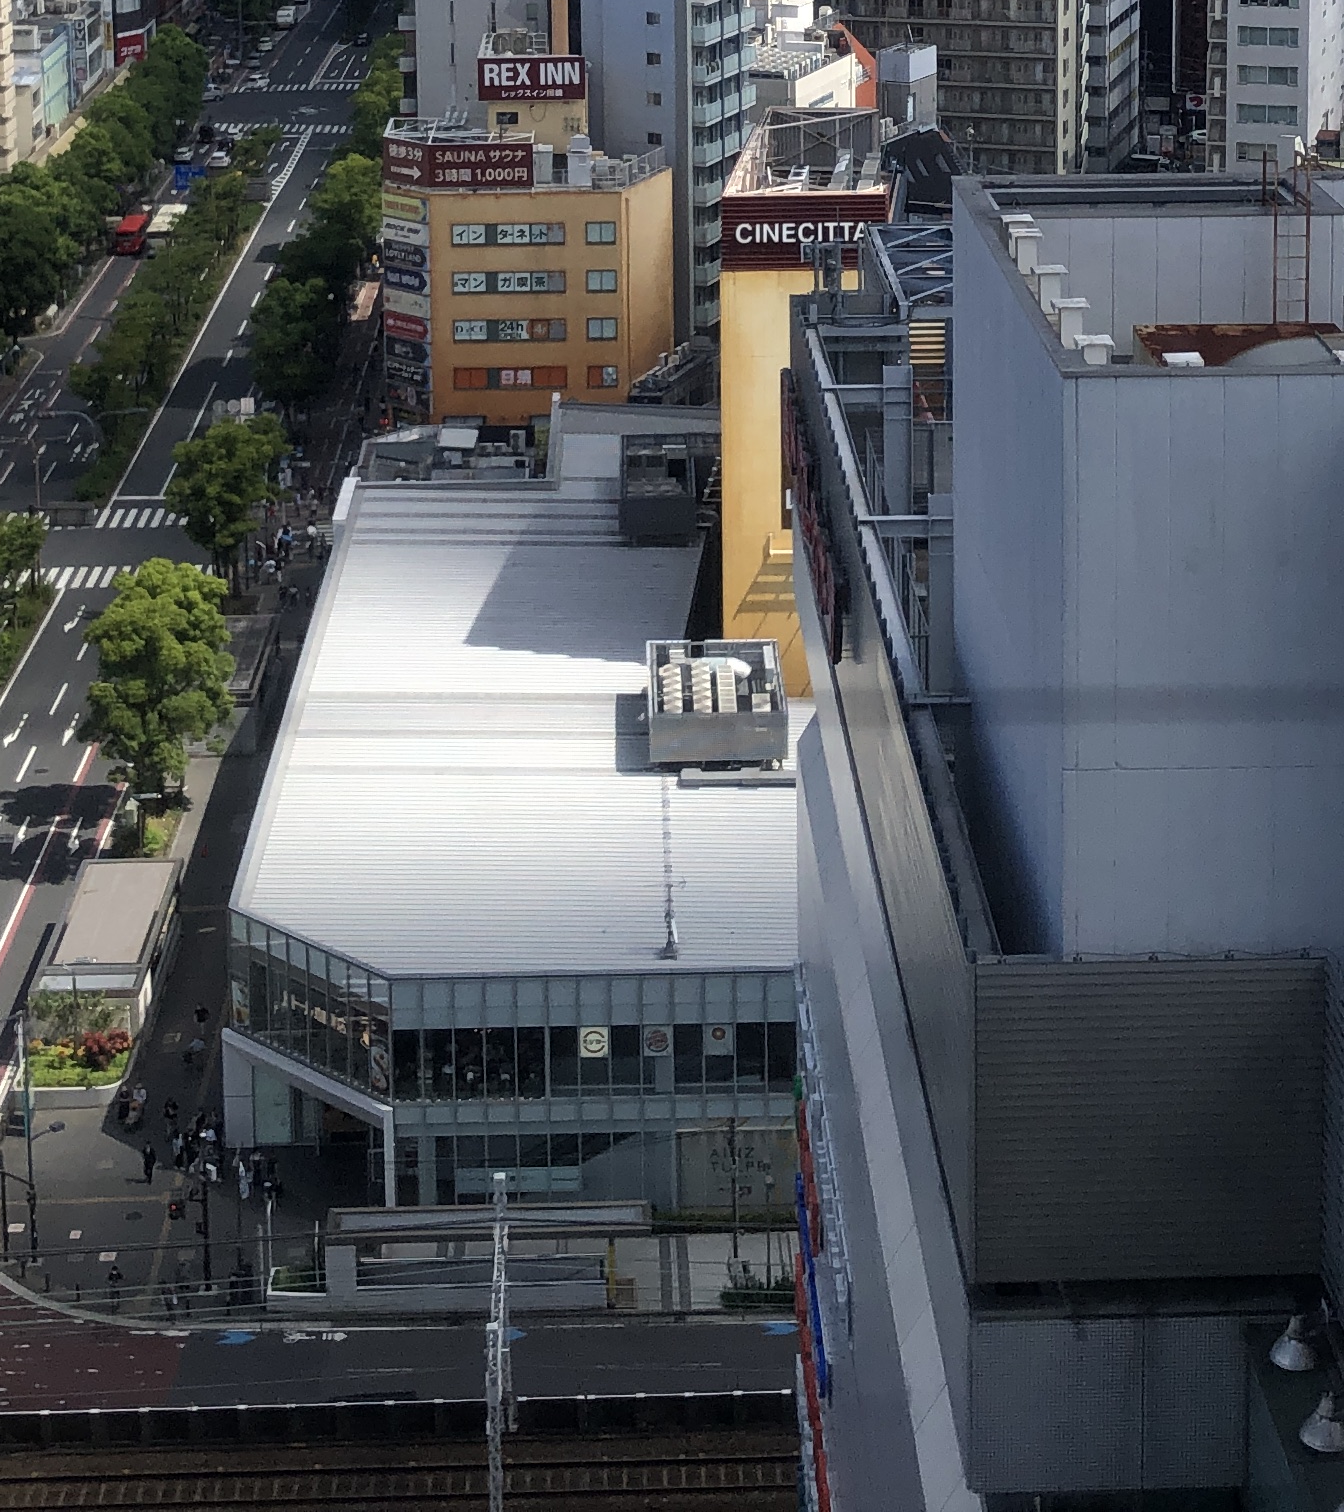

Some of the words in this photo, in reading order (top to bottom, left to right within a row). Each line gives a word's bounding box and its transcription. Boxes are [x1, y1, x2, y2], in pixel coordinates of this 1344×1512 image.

[484, 62, 531, 87] REX
[539, 61, 580, 85] INN
[388, 143, 423, 162] 徒歩3分
[435, 150, 486, 163] SAUNA
[488, 149, 527, 162] サウナ
[435, 168, 472, 182] 3時間
[475, 167, 528, 181] 1,000円
[455, 225, 548, 241] インターネット
[455, 276, 547, 289] マンガ喫茶
[499, 320, 524, 333] 24h
